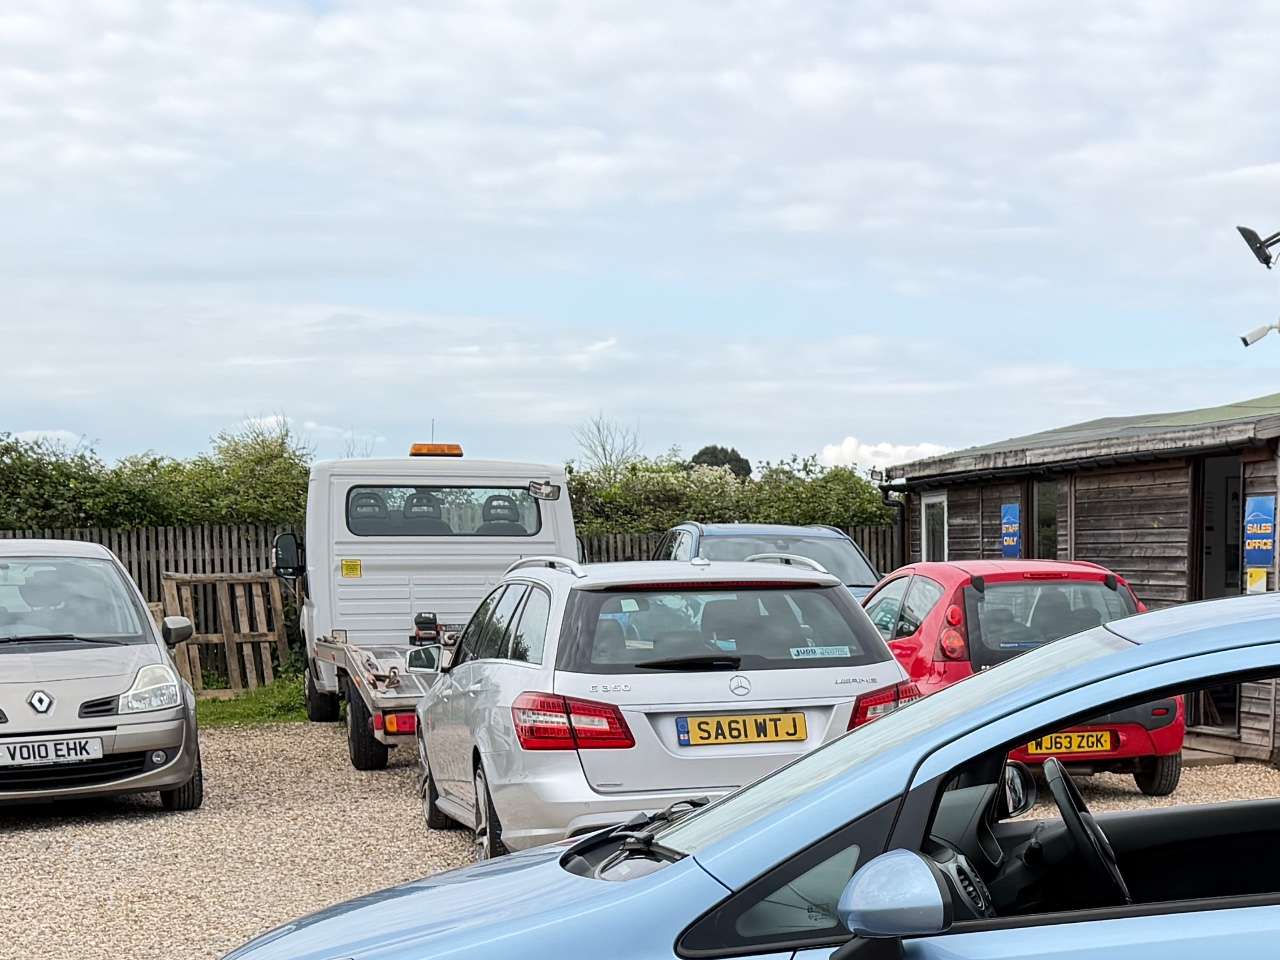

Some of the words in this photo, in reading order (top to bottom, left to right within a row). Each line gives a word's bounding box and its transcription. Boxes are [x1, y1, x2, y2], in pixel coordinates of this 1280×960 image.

[1247, 523, 1272, 534] SALES
[1003, 536, 1018, 545] ONLY
[1246, 539, 1272, 550] OFFICE
[697, 719, 749, 741] SA61
[755, 717, 799, 739] WTJ
[1034, 734, 1073, 751] WJ63
[1077, 733, 1105, 749] ZGK
[6, 743, 49, 761] VO10
[54, 740, 90, 758] EHK
